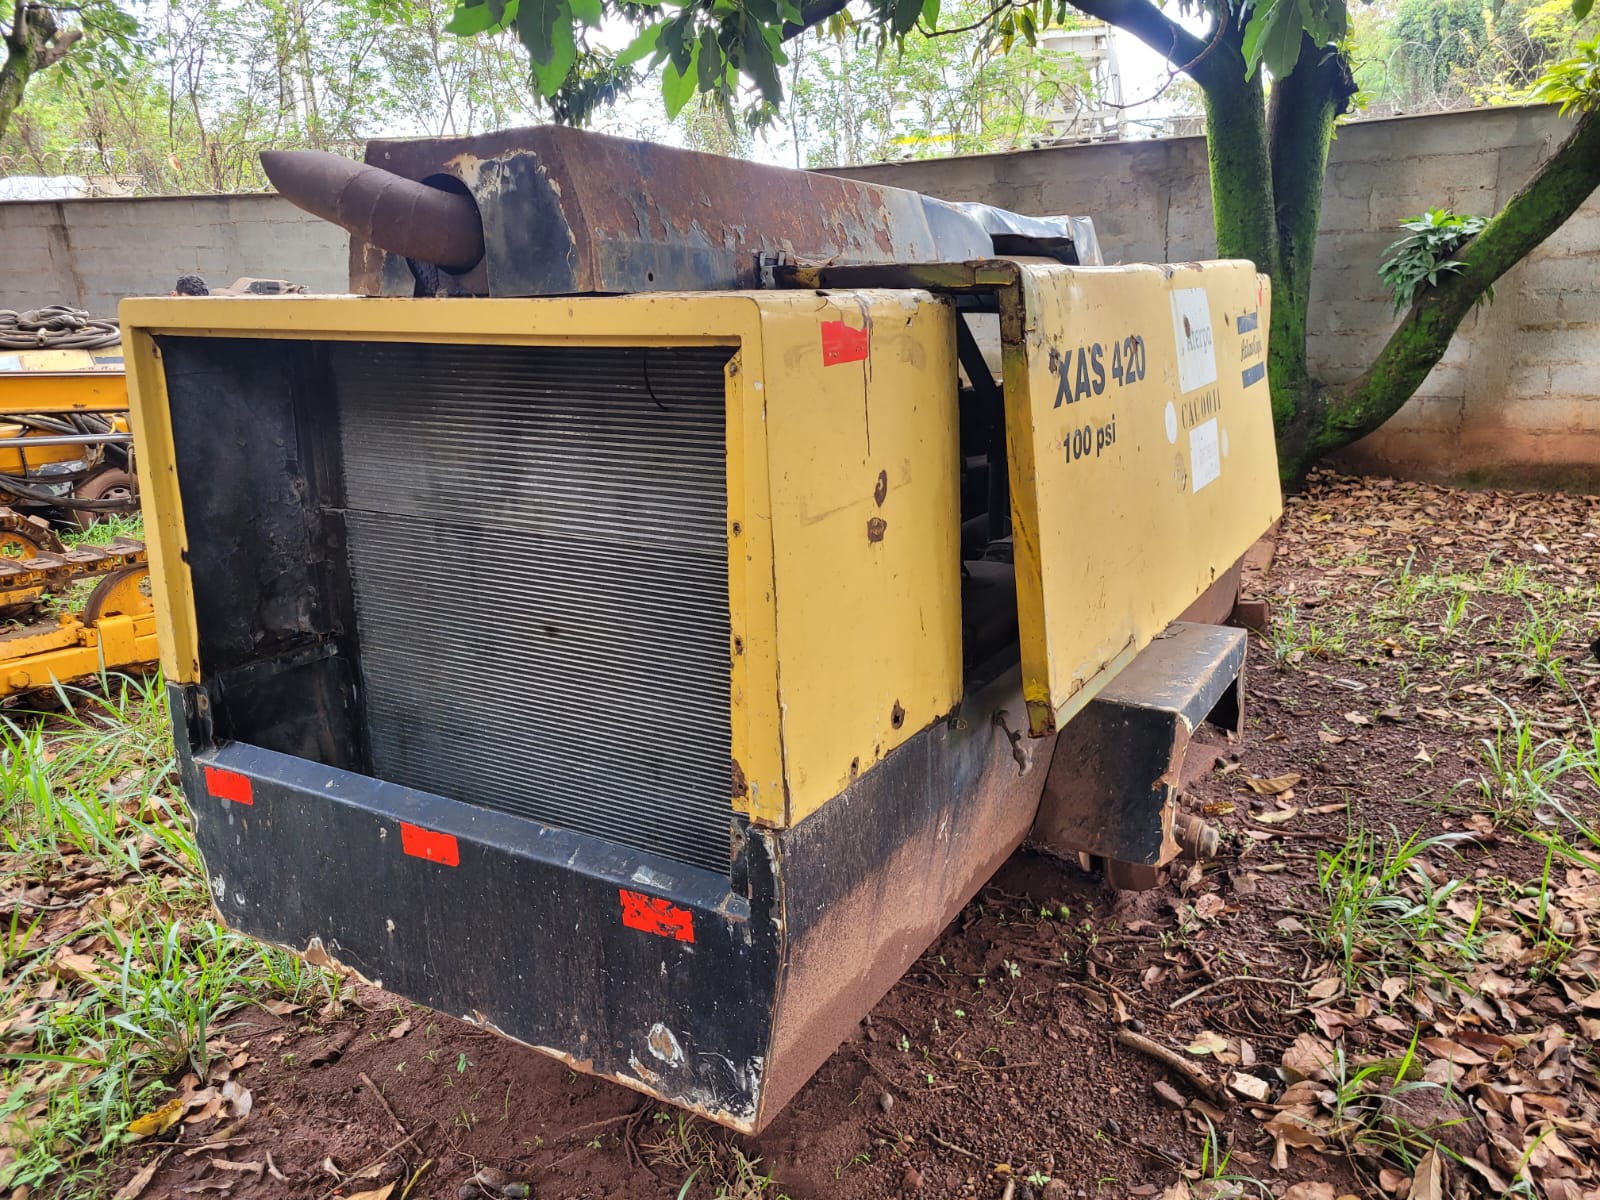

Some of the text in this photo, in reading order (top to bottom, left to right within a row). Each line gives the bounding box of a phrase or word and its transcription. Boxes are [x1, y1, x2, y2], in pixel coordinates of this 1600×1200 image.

[1053, 335, 1146, 409] XAS 420
[1063, 413, 1116, 464] 100 psi
